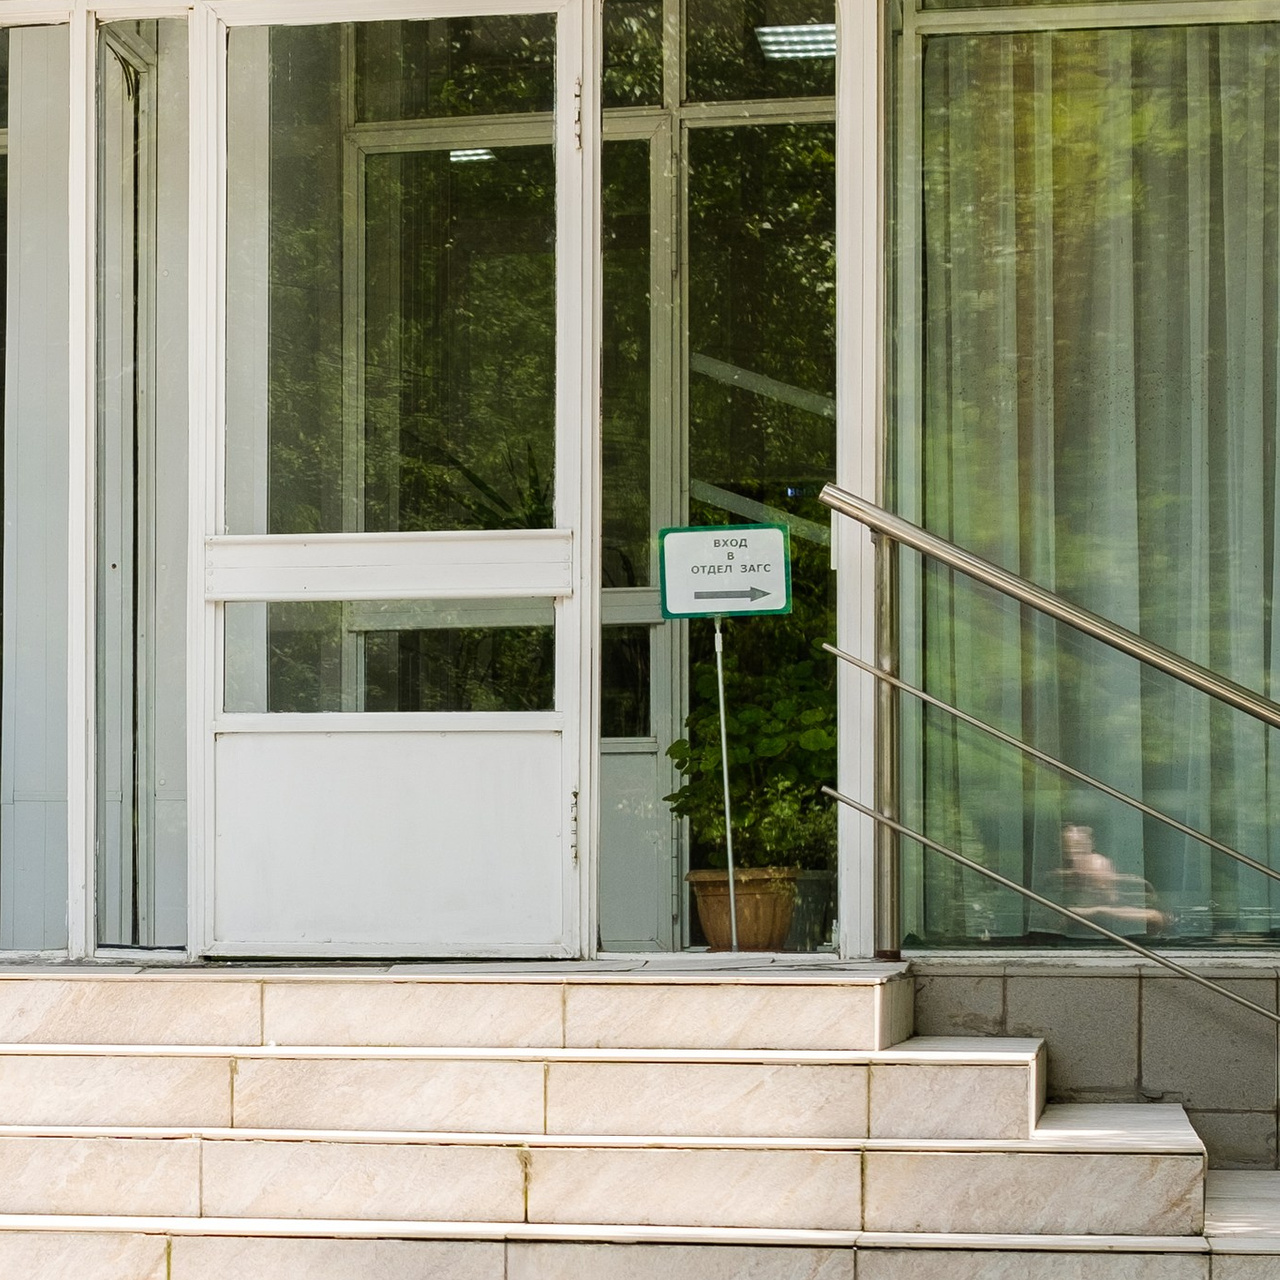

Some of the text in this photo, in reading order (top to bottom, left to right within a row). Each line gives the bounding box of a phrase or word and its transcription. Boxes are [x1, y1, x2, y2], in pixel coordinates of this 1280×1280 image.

[713, 538, 748, 549] ВХОД
[727, 552, 735, 560] В
[691, 563, 771, 575] ОТДЕЛ ЗАГС
